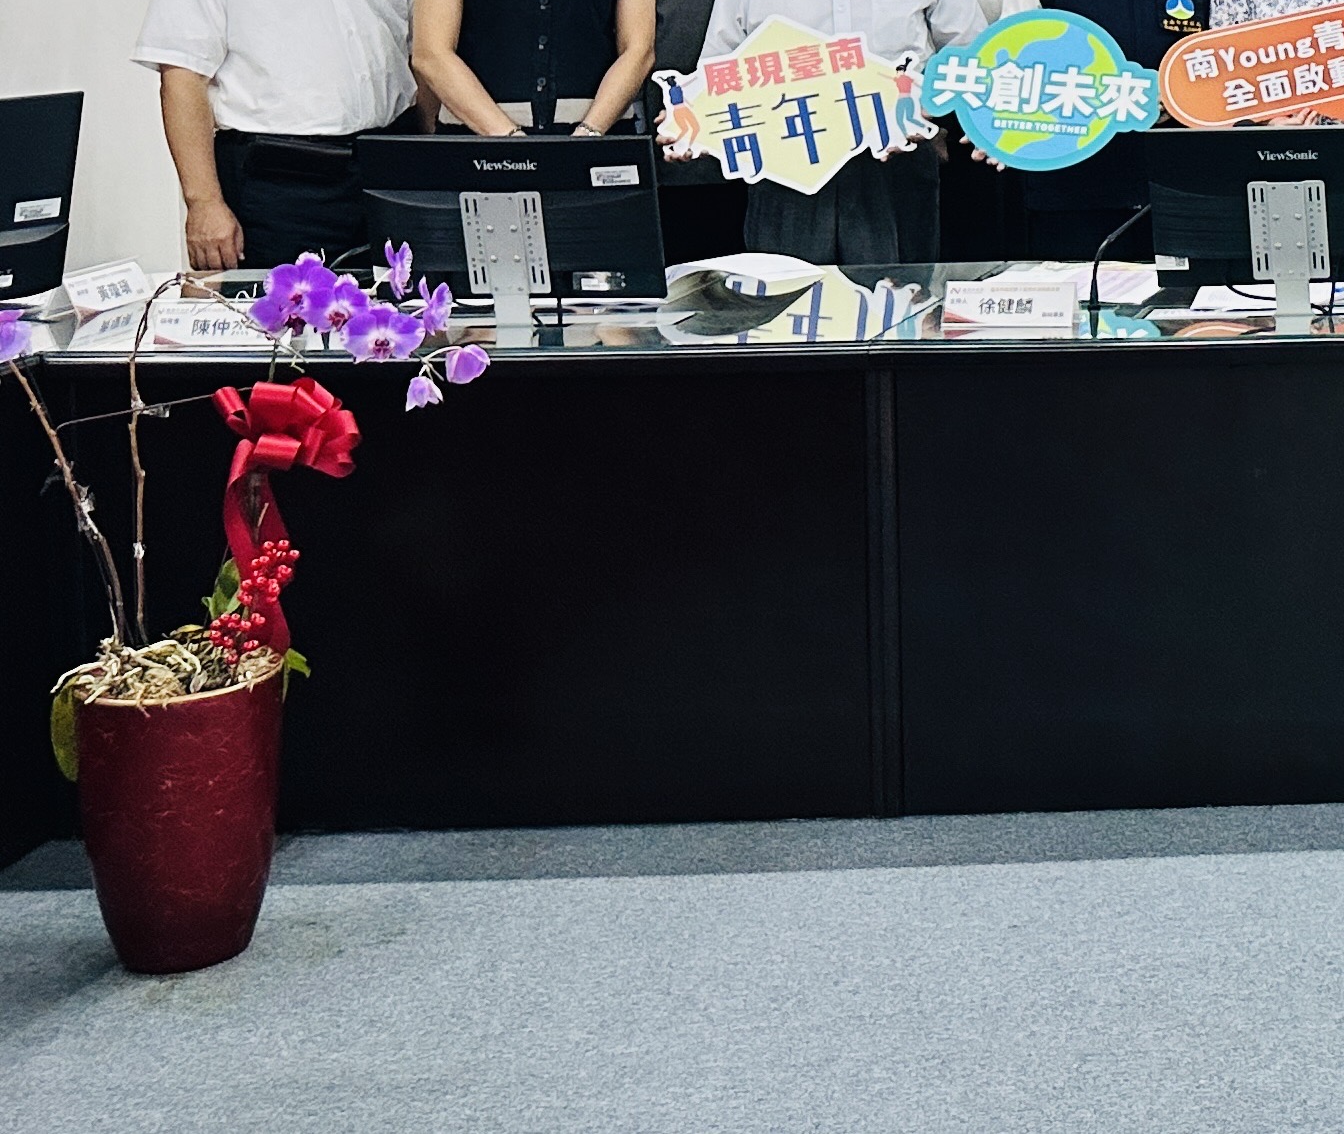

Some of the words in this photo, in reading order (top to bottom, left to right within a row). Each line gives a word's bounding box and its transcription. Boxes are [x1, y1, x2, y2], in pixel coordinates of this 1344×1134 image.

[703, 37, 866, 97] 展現臺南
[931, 55, 1152, 122] 共創未來
[704, 80, 890, 179] 青年力
[993, 119, 1033, 131] BETTER
[1034, 122, 1089, 136] TOGETHER
[473, 159, 538, 171] ViewSonic
[1257, 149, 1319, 161] ViewSonic
